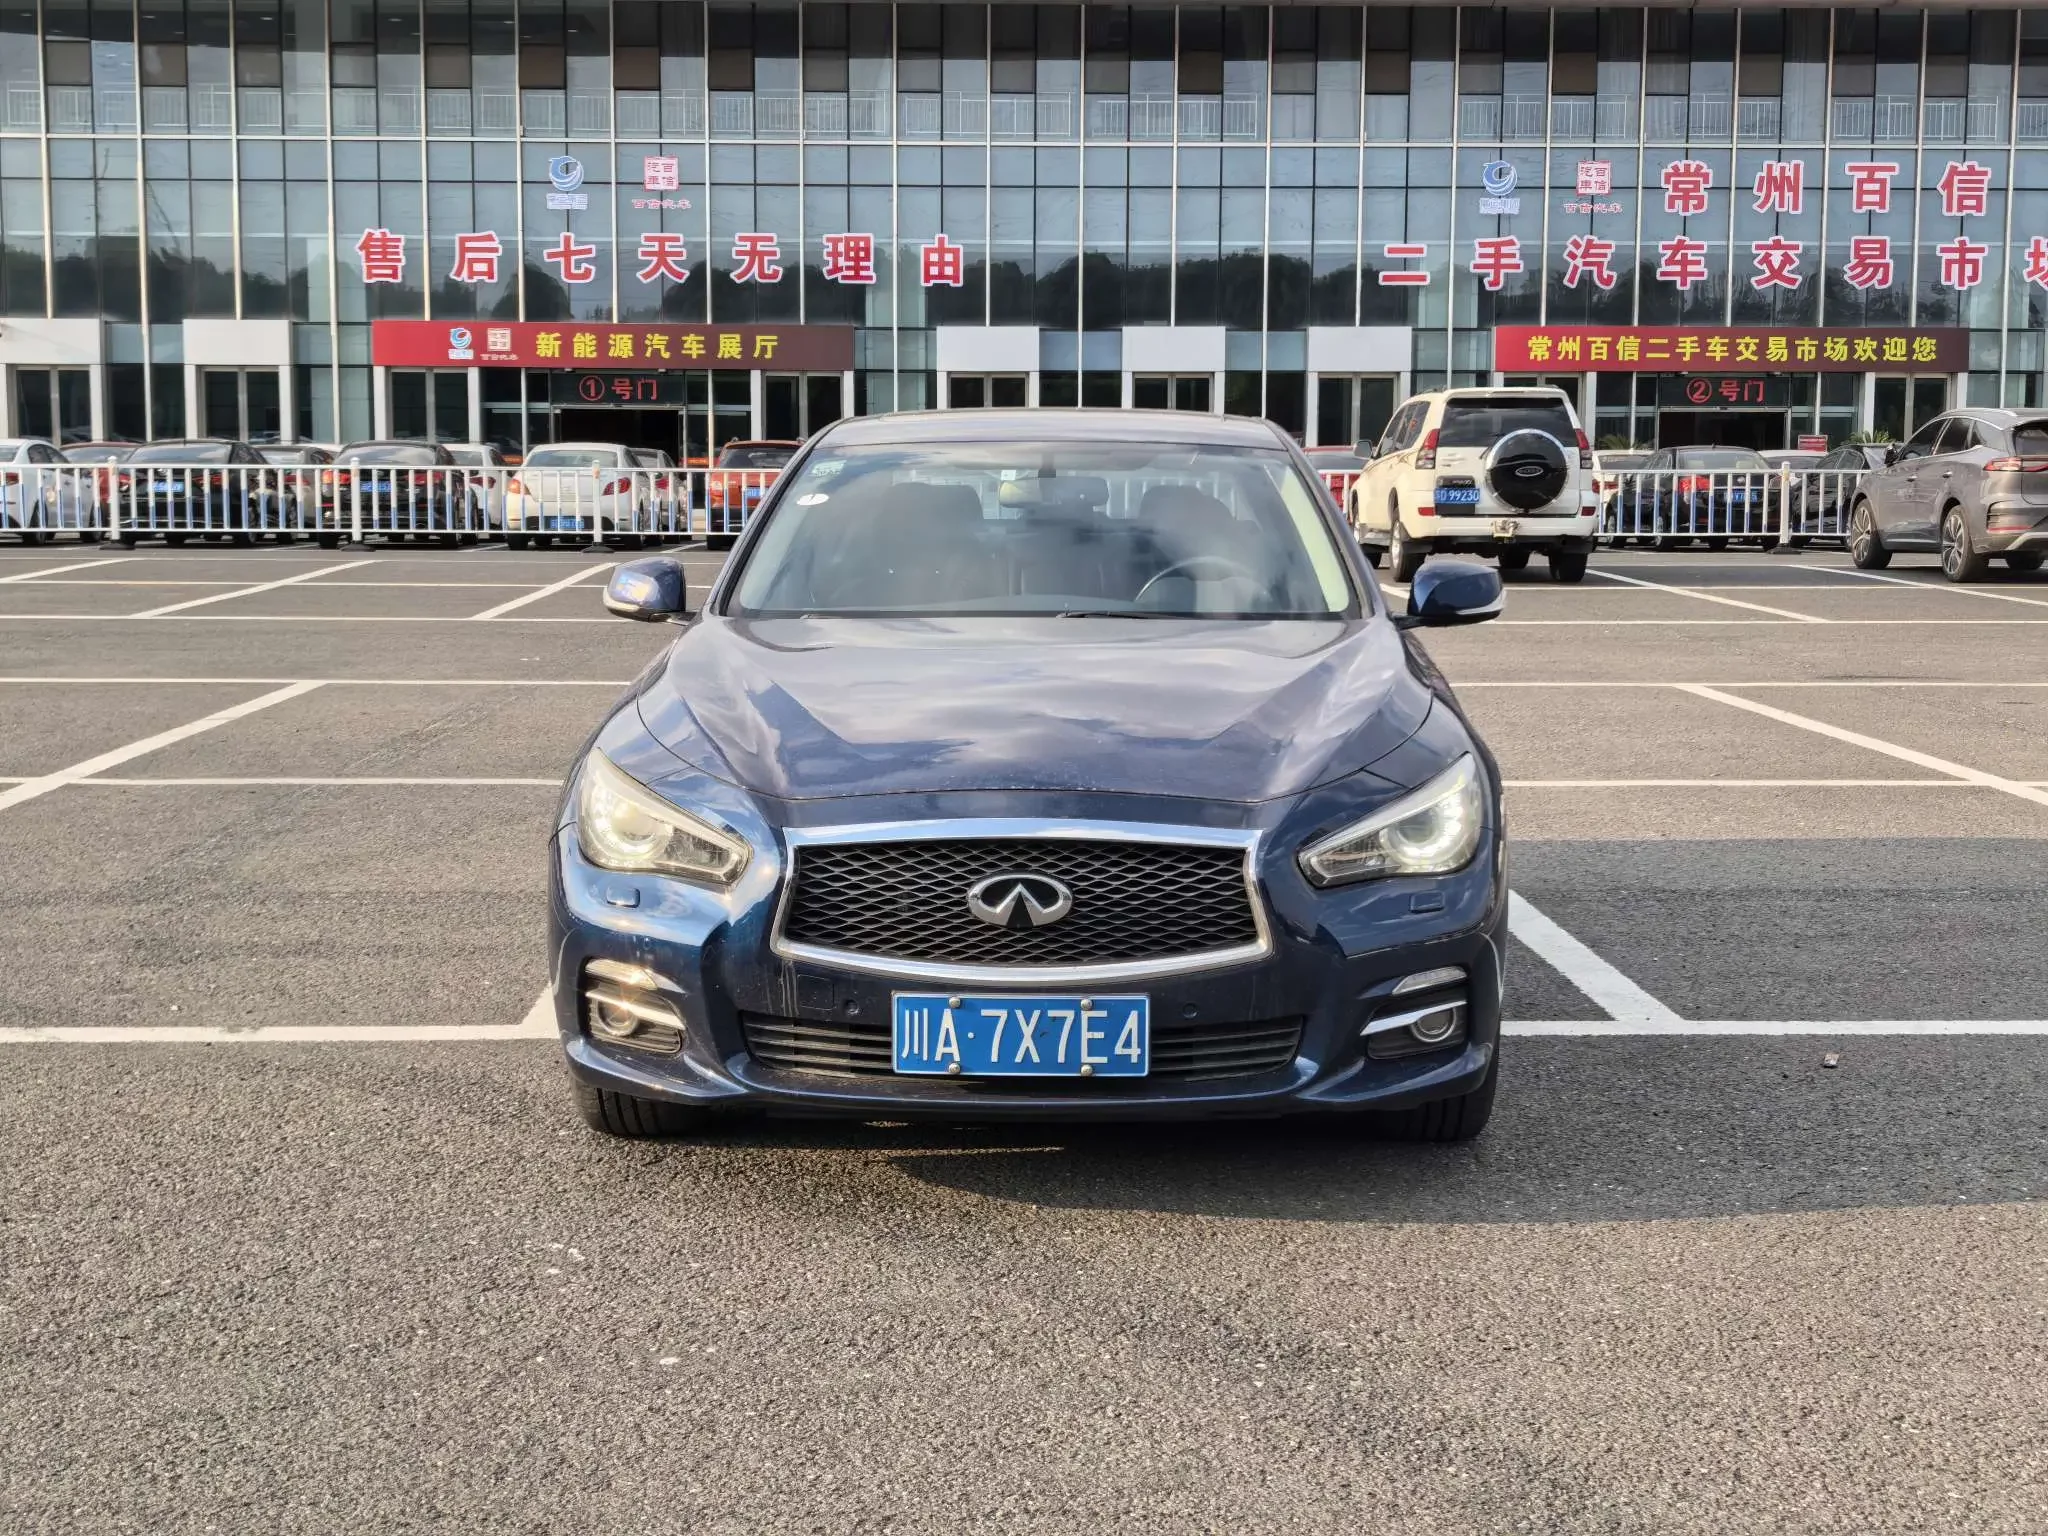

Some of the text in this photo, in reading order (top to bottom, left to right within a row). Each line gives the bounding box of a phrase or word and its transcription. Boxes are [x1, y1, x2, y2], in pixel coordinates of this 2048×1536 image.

[1662, 162, 1991, 215] 常州百信
[357, 229, 963, 287] 售后七天无理由
[535, 333, 778, 360] 新能源汽车展厅
[1528, 335, 1937, 362] 常州百信二手车交易市场欢迎您
